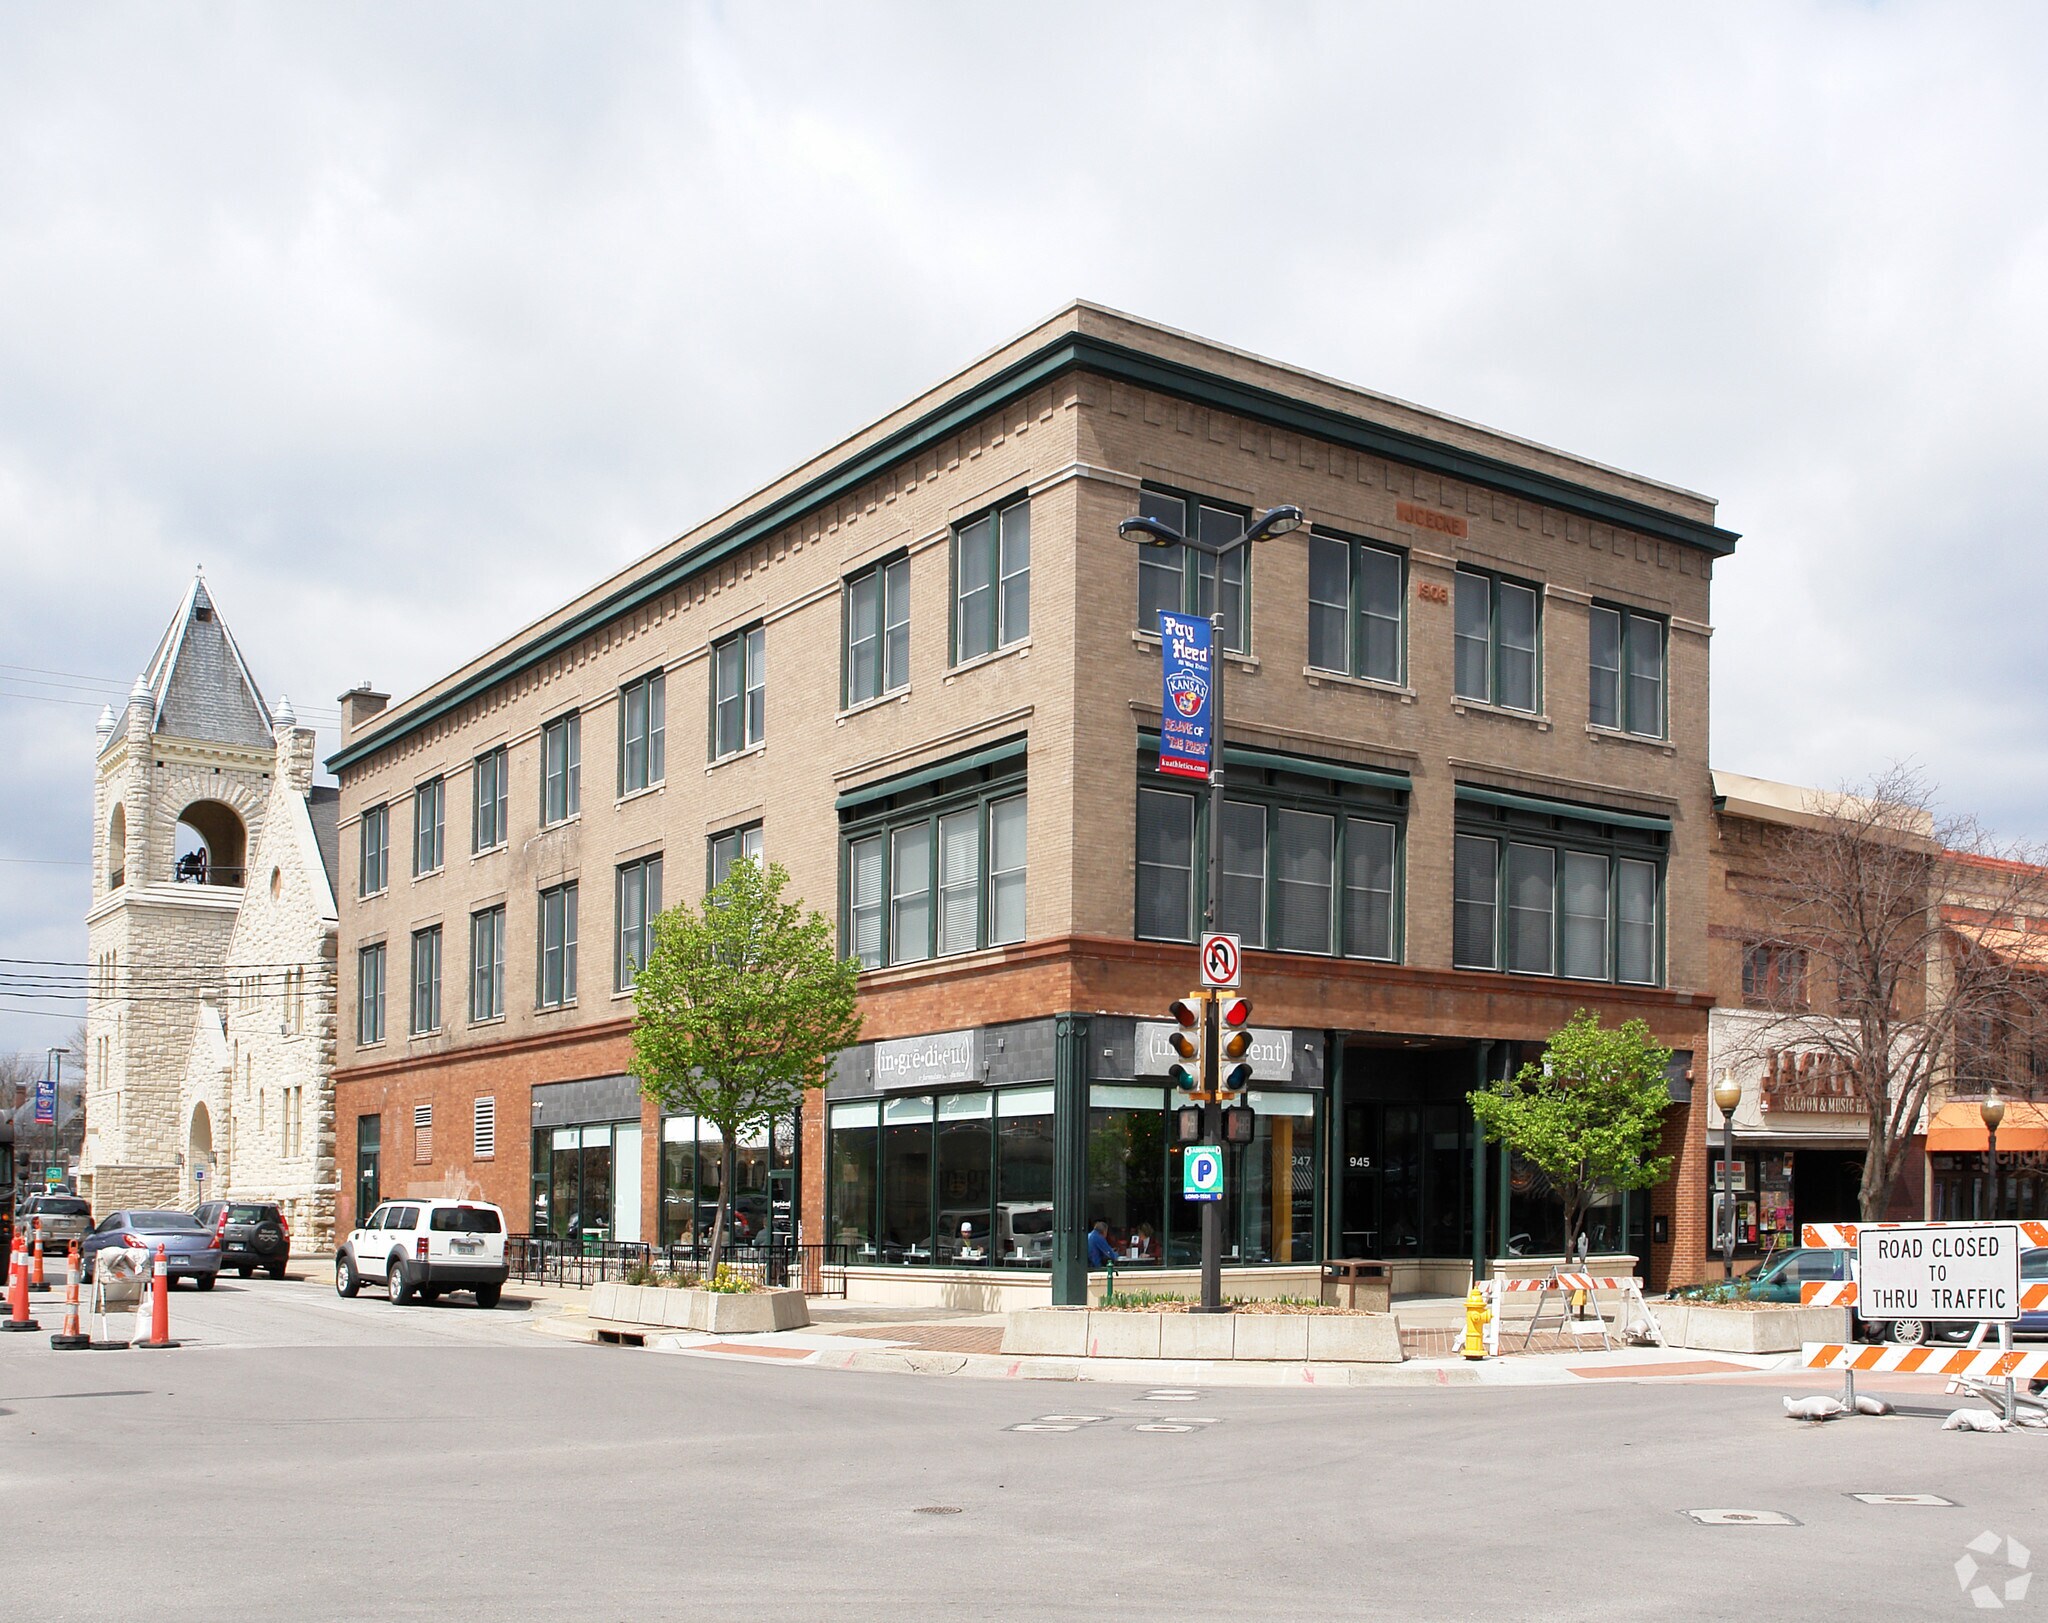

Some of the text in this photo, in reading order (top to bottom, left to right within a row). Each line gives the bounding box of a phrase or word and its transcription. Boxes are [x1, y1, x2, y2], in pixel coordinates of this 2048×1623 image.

[1163, 616, 1194, 643] Pay
[1172, 638, 1208, 662] Heed
[1170, 679, 1206, 697] KANSAS
[1193, 726, 1204, 737] OF
[1161, 757, 1206, 773] kuathletics.com
[1783, 1095, 1818, 1113] SALOON
[1819, 1097, 1827, 1113] &
[1828, 1097, 1855, 1113] MUSIC
[1291, 1155, 1311, 1167] 947
[1349, 1156, 1371, 1168] 945
[1198, 1160, 1211, 1182] P
[1878, 1236, 1999, 1260] ROAD CLOSED
[1929, 1264, 1947, 1282] TO
[1872, 1288, 2006, 1309] THRU TRAFFIC
